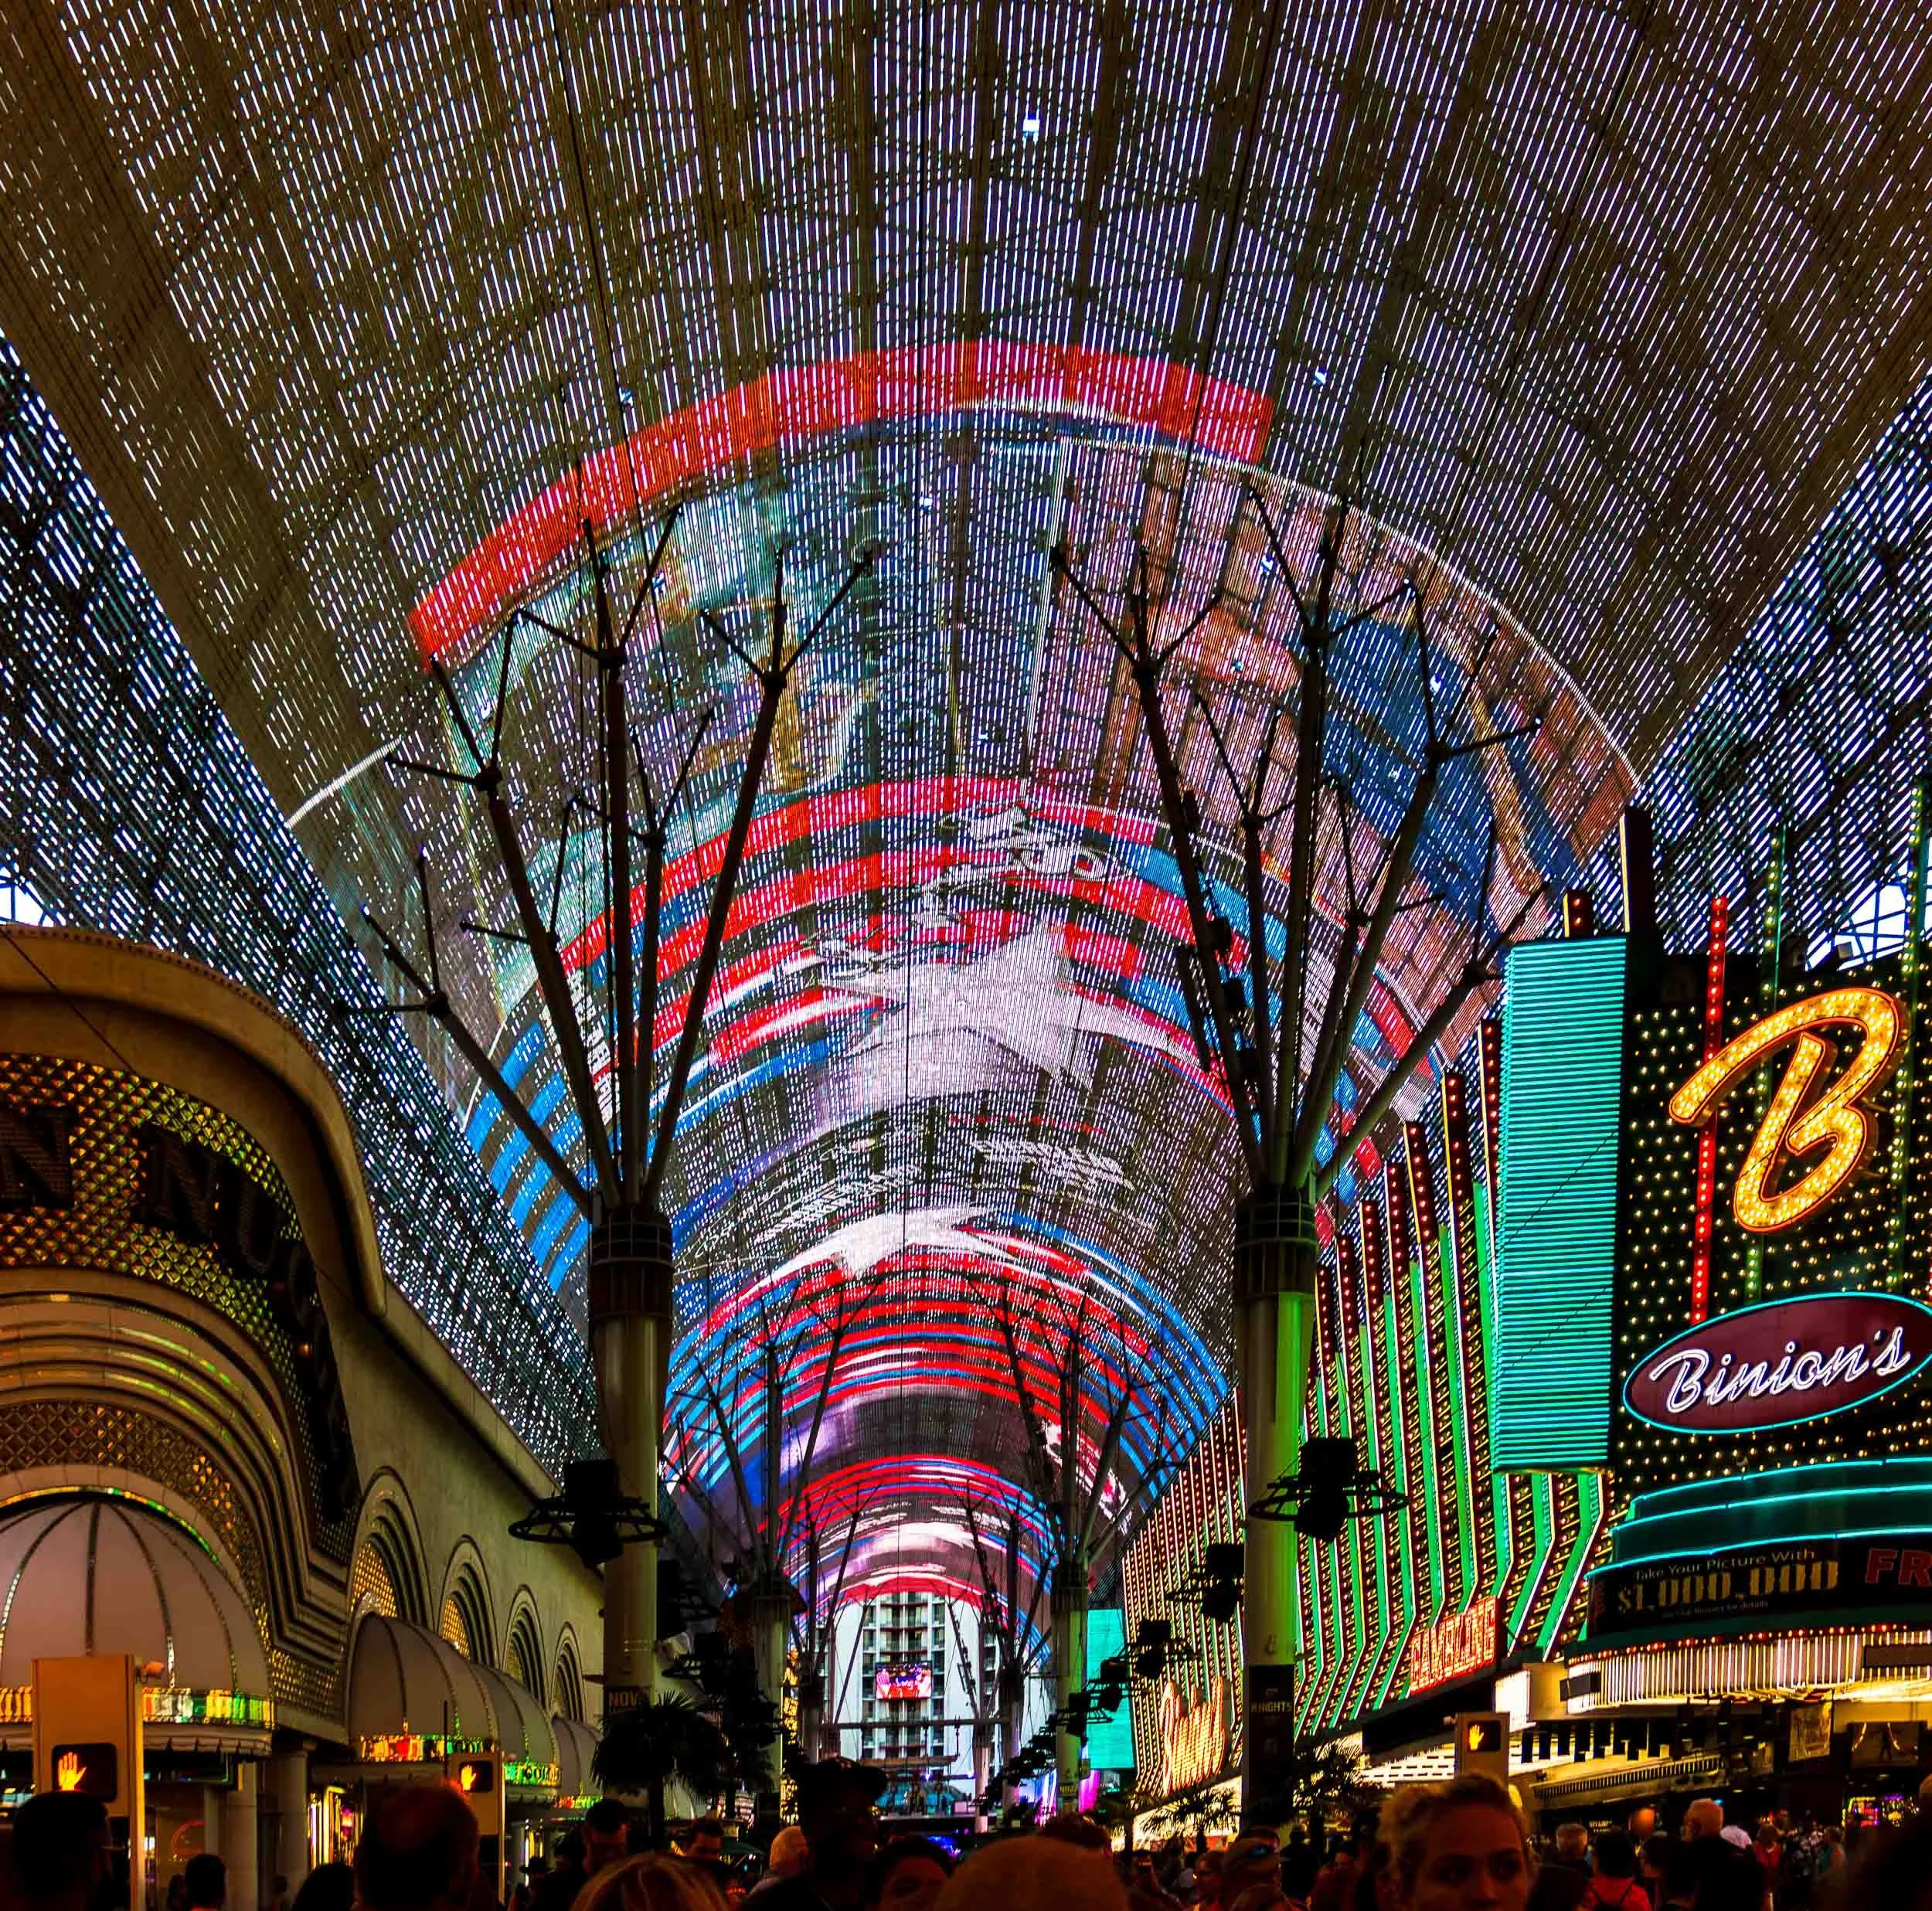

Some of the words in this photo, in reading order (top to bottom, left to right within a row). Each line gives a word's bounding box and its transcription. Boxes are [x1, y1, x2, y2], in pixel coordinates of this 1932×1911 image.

[1669, 988, 1899, 1233] B
[1650, 1327, 1910, 1414] Binion's
[1634, 1569, 1664, 1581] Take
[1668, 1562, 1702, 1576] Your
[1706, 1553, 1767, 1571] Picture
[1771, 1545, 1815, 1563] With
[1865, 1548, 1932, 1586] FR
[1410, 1596, 1497, 1694] GAMBLING
[1250, 1701, 1292, 1713] KNIGHTS
